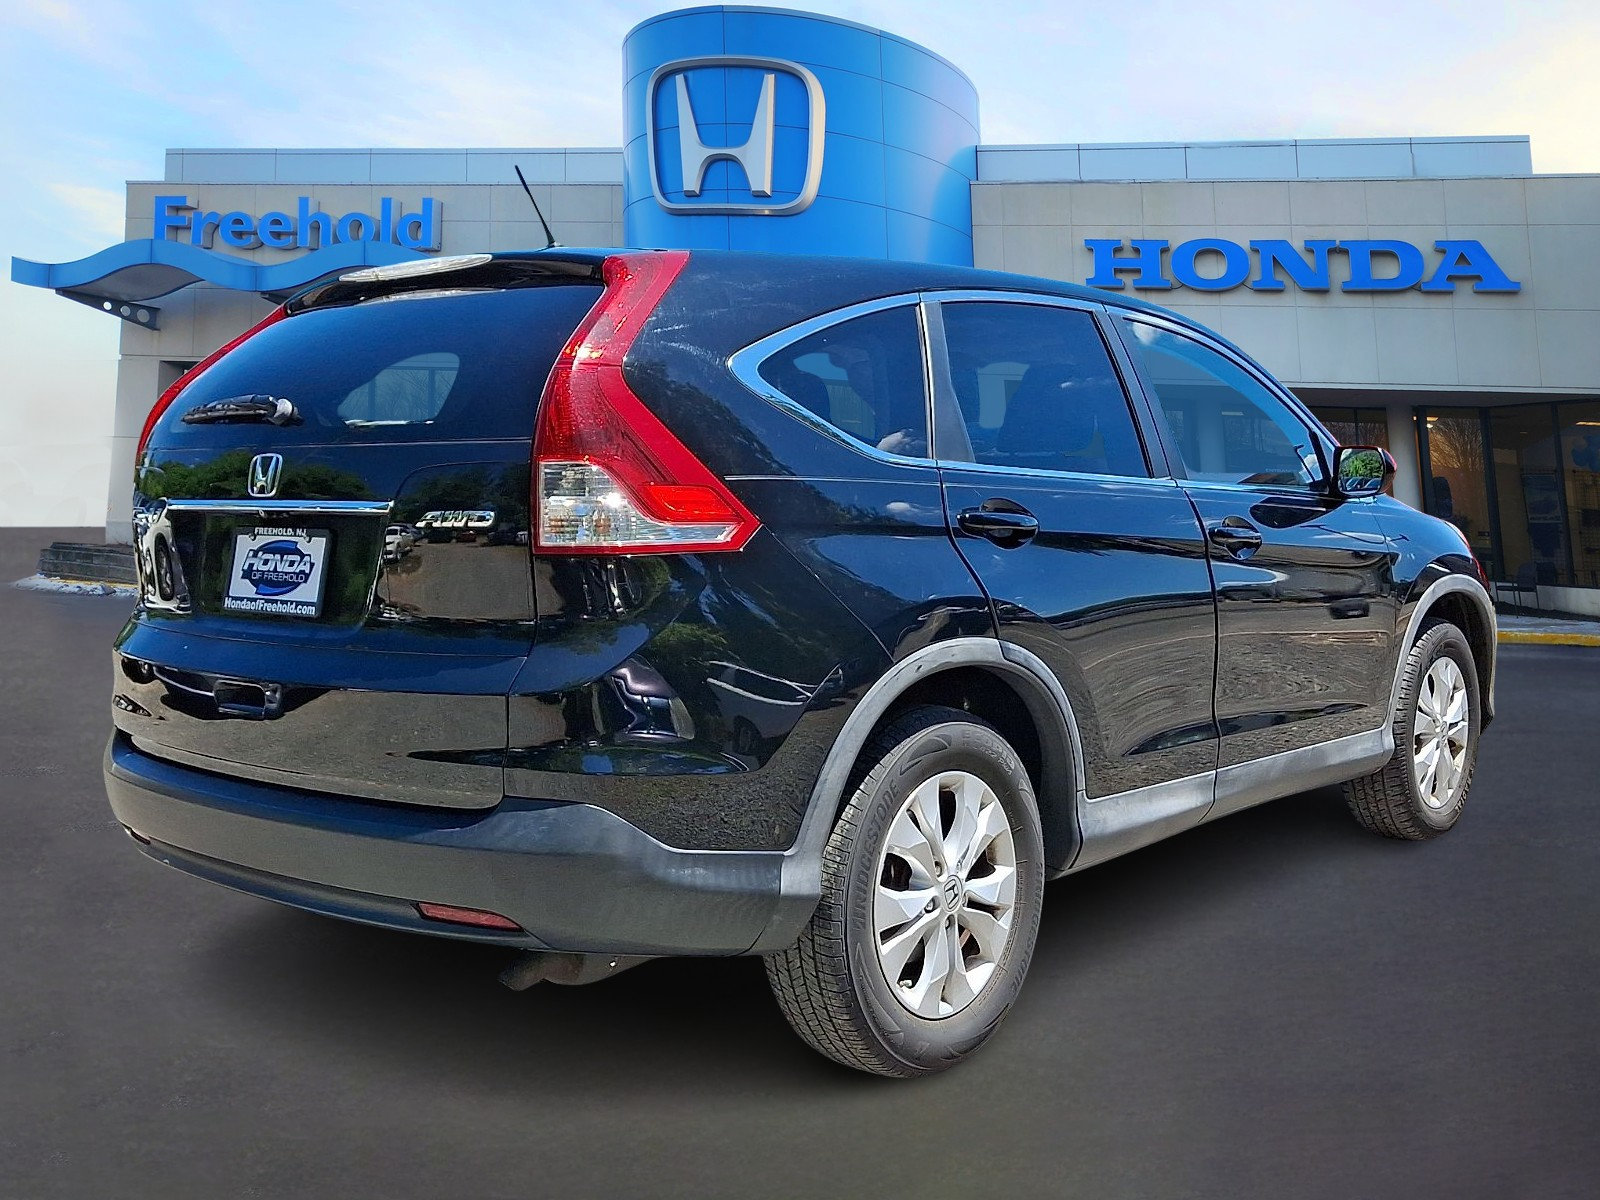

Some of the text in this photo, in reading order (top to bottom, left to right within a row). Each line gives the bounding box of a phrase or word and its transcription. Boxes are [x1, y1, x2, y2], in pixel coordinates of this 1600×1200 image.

[153, 195, 441, 250] Freehold
[1084, 238, 1521, 293] HONDA
[415, 510, 495, 528] AWD
[243, 551, 311, 574] HONDA
[251, 571, 305, 582] OF FREEHOLD
[224, 597, 316, 615] HondaofFreehold.com
